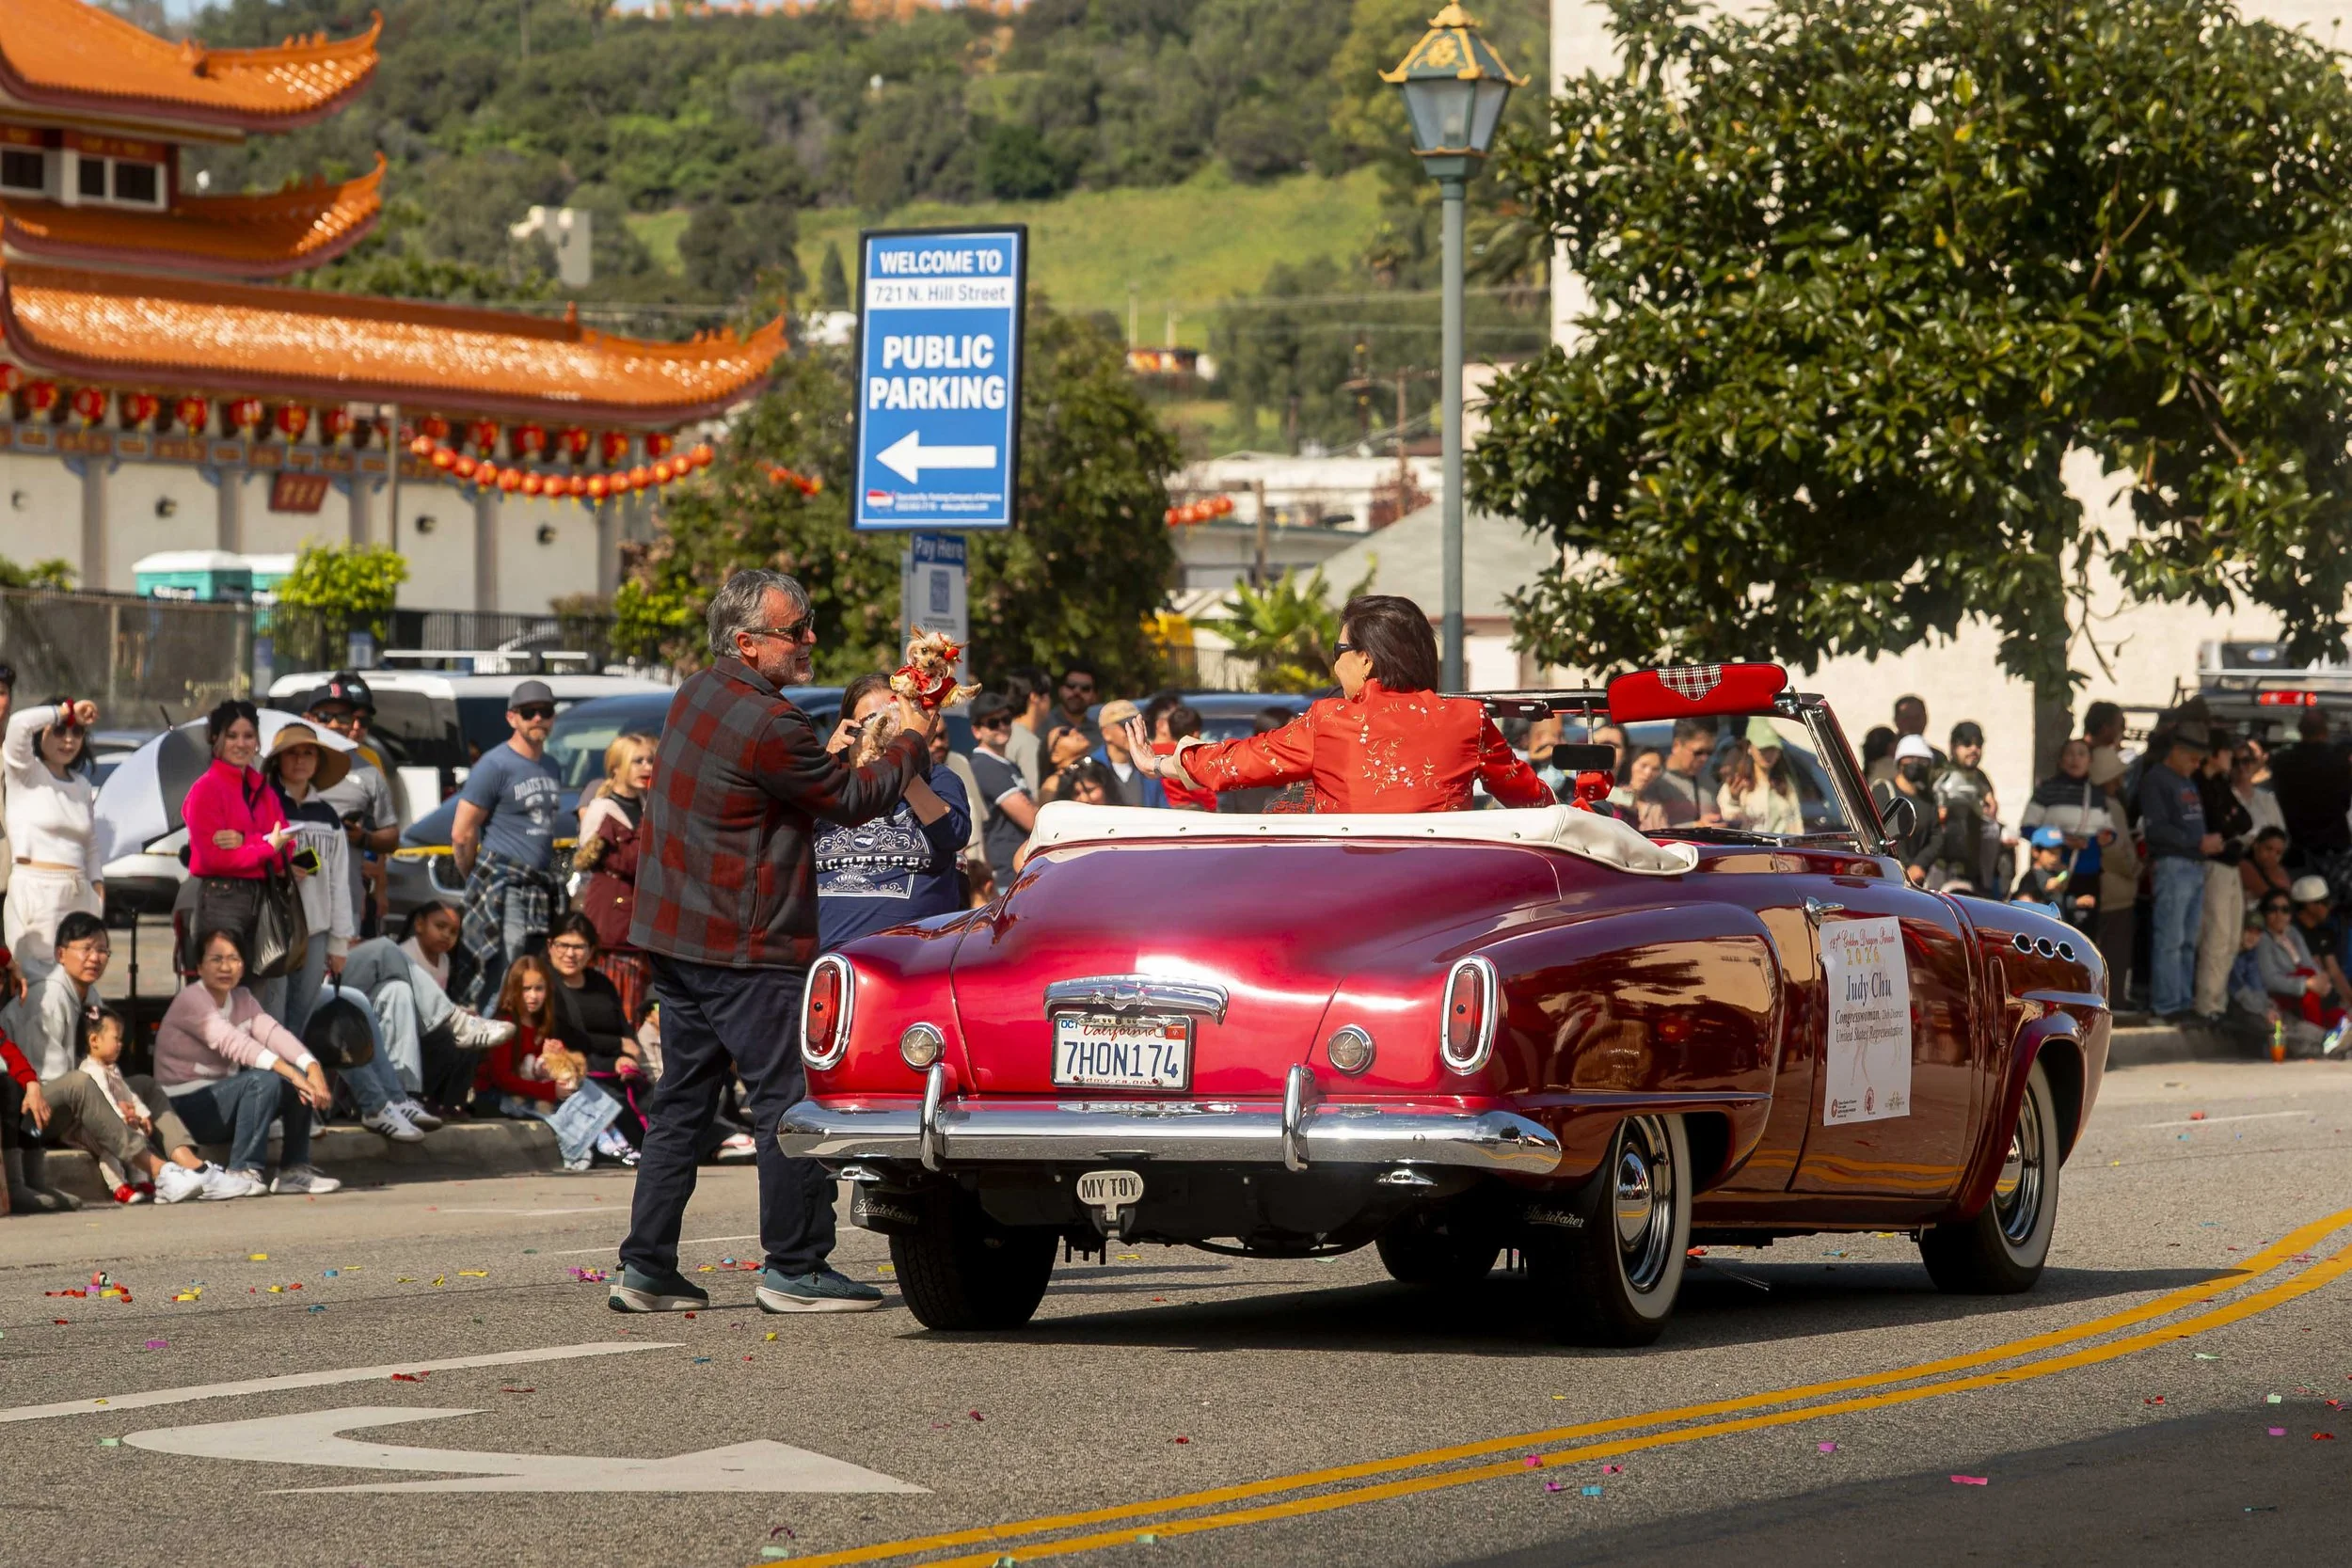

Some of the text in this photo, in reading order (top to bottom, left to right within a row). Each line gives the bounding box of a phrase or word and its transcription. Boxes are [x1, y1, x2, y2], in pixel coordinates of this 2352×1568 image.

[880, 248, 1004, 274] WELCOME TO
[875, 283, 1006, 303] 721 N. Hill Street
[882, 334, 994, 370] PUBLIC
[868, 374, 1007, 411] PARKING
[914, 535, 963, 561] Pay Here
[1841, 928, 1859, 948] Golden
[1860, 927, 1879, 952] Dragon
[1846, 946, 1880, 966] 2026
[1846, 972, 1892, 1006] Judy Chu
[1835, 1008, 1882, 1028] Congresswoman,
[1083, 1024, 1158, 1041] California
[1836, 1023, 1904, 1043] United States Representative
[1081, 1177, 1136, 1198] MY TOY
[853, 1196, 919, 1225] Studebaker
[1523, 1203, 1585, 1228] Studebaker
